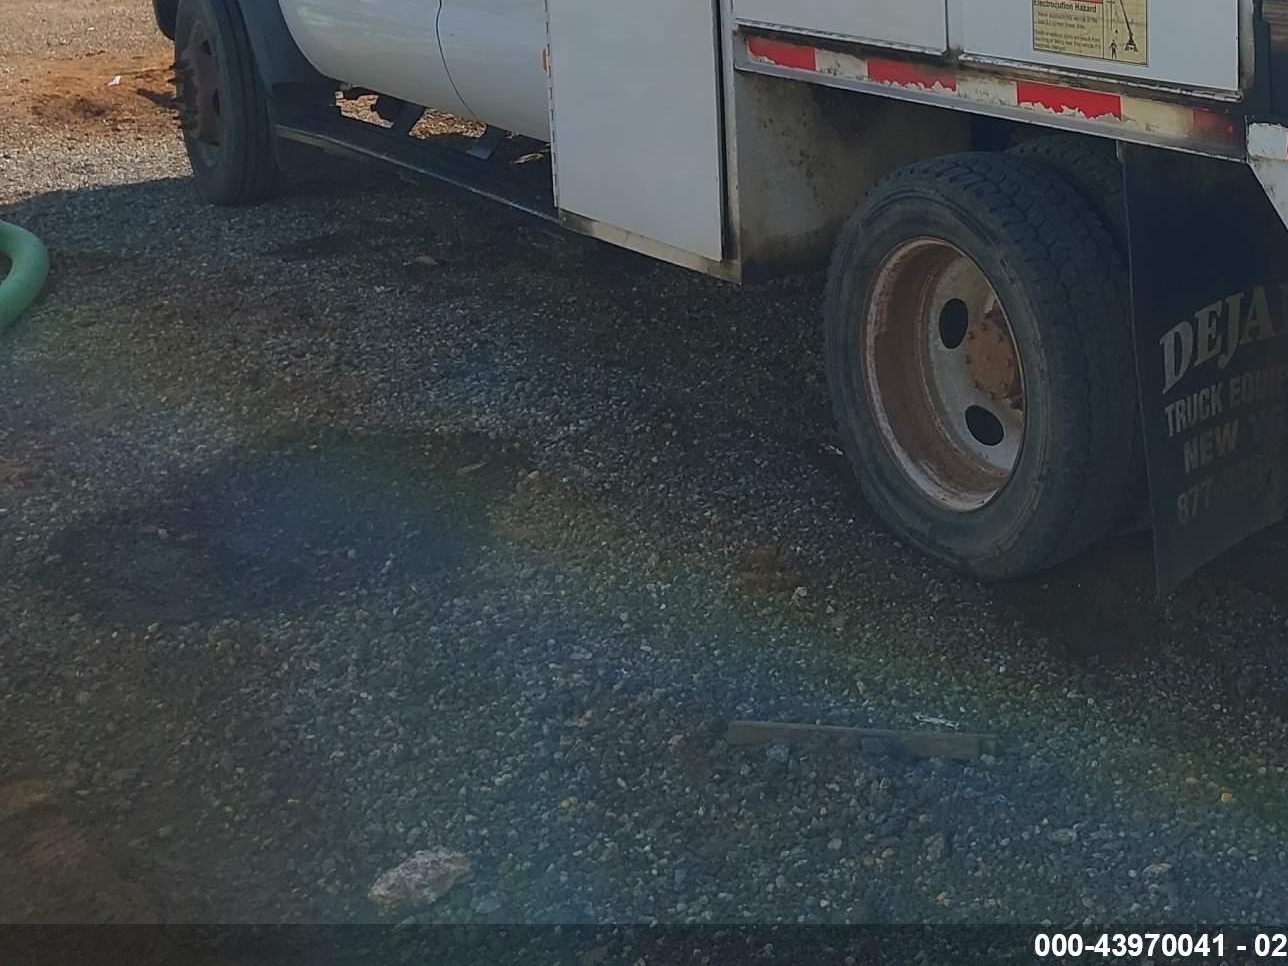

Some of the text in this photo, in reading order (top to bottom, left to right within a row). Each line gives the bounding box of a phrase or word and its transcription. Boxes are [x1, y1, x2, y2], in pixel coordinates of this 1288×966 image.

[1075, 3, 1097, 13] Hazard
[1164, 381, 1224, 437] TRUCK
[1183, 418, 1240, 475] NEW
